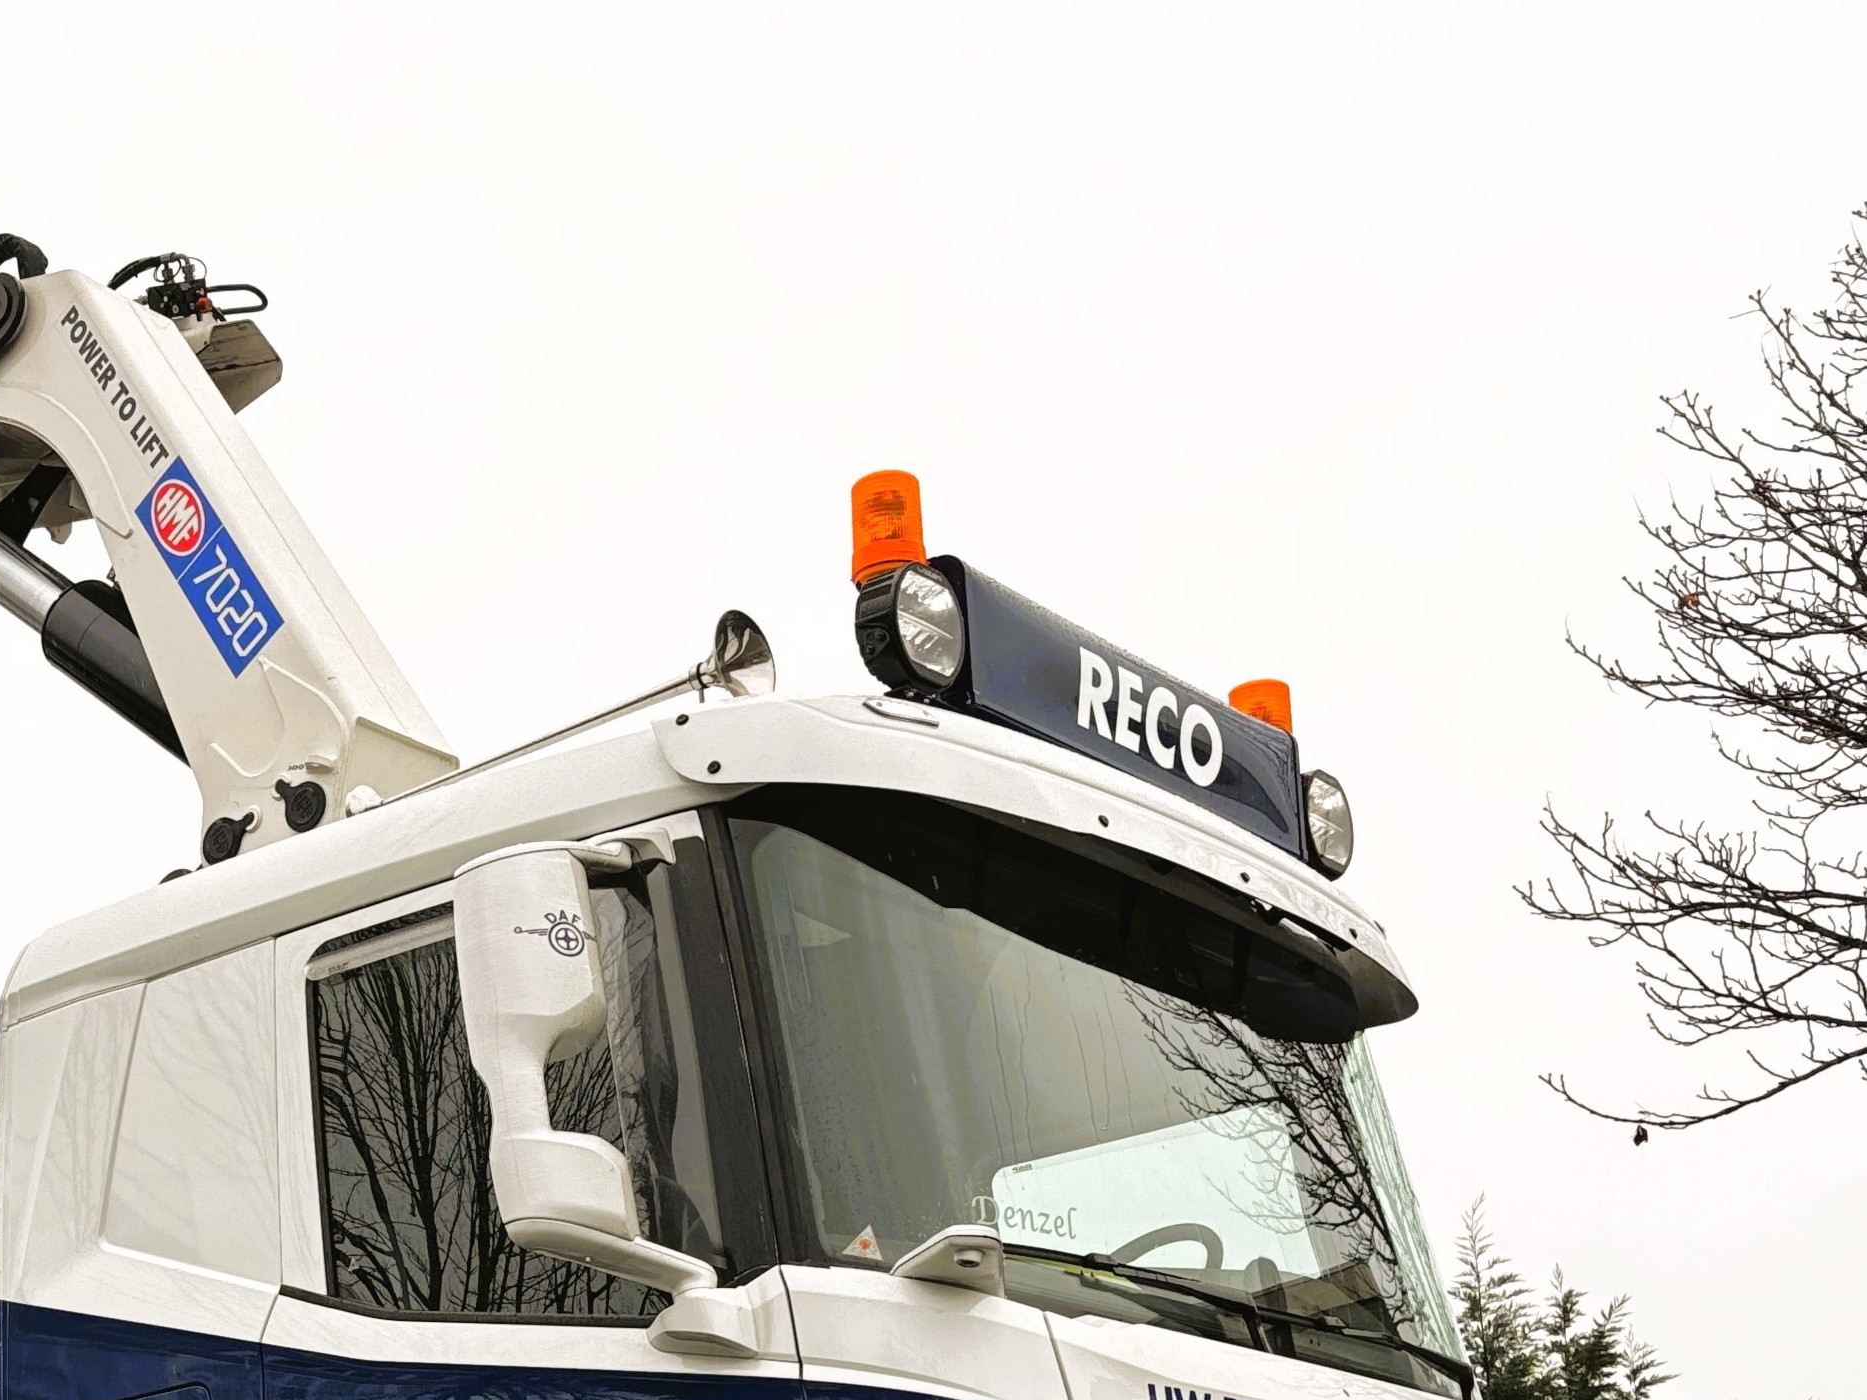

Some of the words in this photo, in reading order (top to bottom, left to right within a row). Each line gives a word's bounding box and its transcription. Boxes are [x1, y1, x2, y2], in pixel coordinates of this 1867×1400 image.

[60, 304, 117, 392] POWER
[110, 381, 138, 421] TO
[130, 412, 169, 470] LIFT
[155, 486, 199, 547] HMF
[192, 542, 269, 658] 7020
[1076, 646, 1224, 788] RECO
[543, 909, 582, 924] DAF
[971, 1195, 1078, 1240] Denzel
